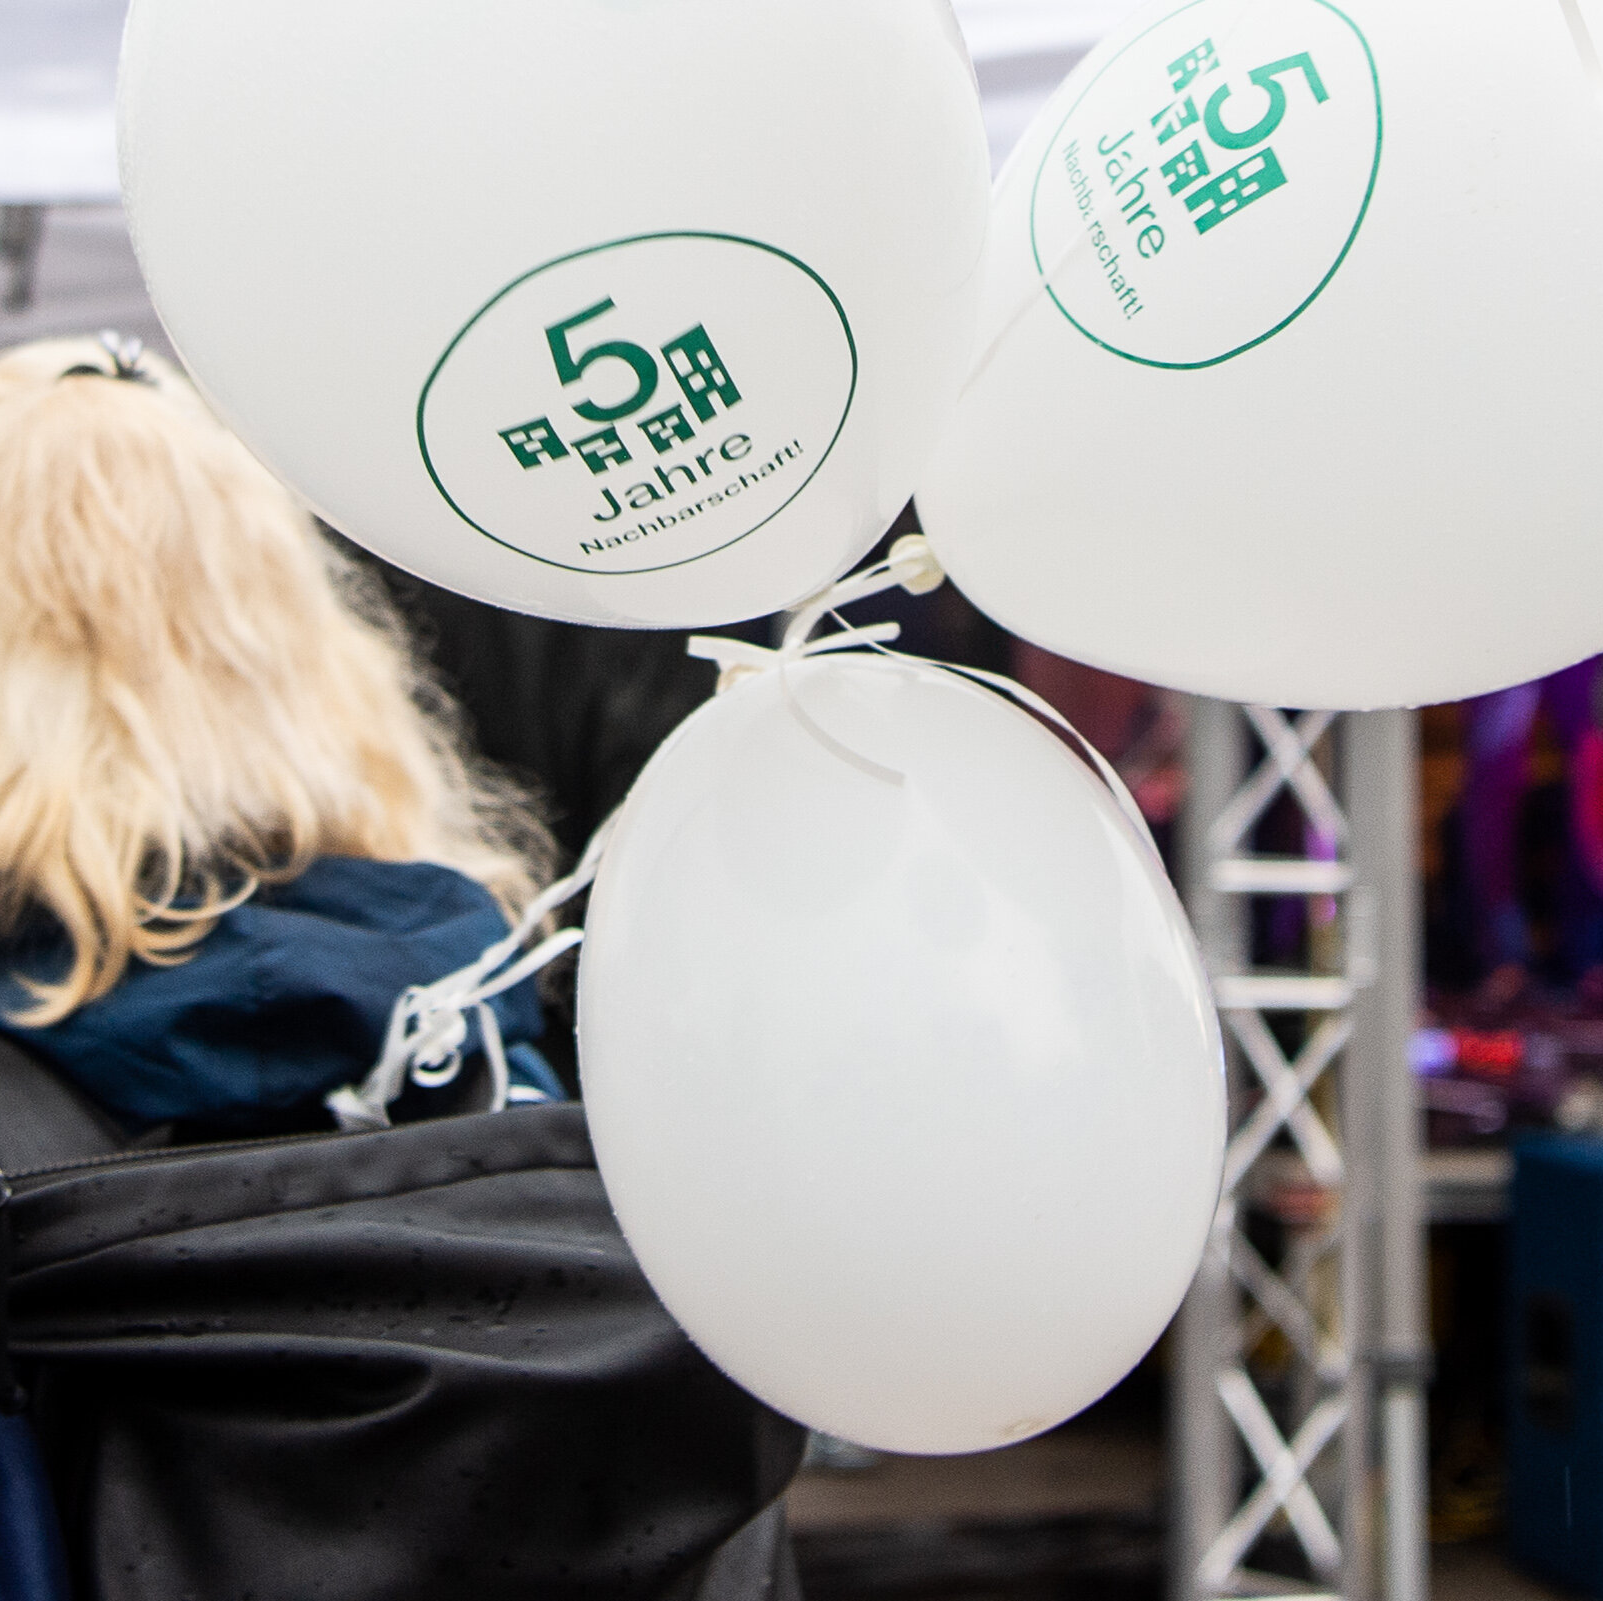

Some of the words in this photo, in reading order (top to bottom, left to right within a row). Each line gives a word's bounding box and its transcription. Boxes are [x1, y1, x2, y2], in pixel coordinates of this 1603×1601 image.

[1203, 52, 1329, 150] 5
[1097, 131, 1165, 259] Jahre
[545, 295, 659, 423] 5
[580, 439, 804, 556] Nachbarschaft!
[593, 433, 753, 523] Jahre
